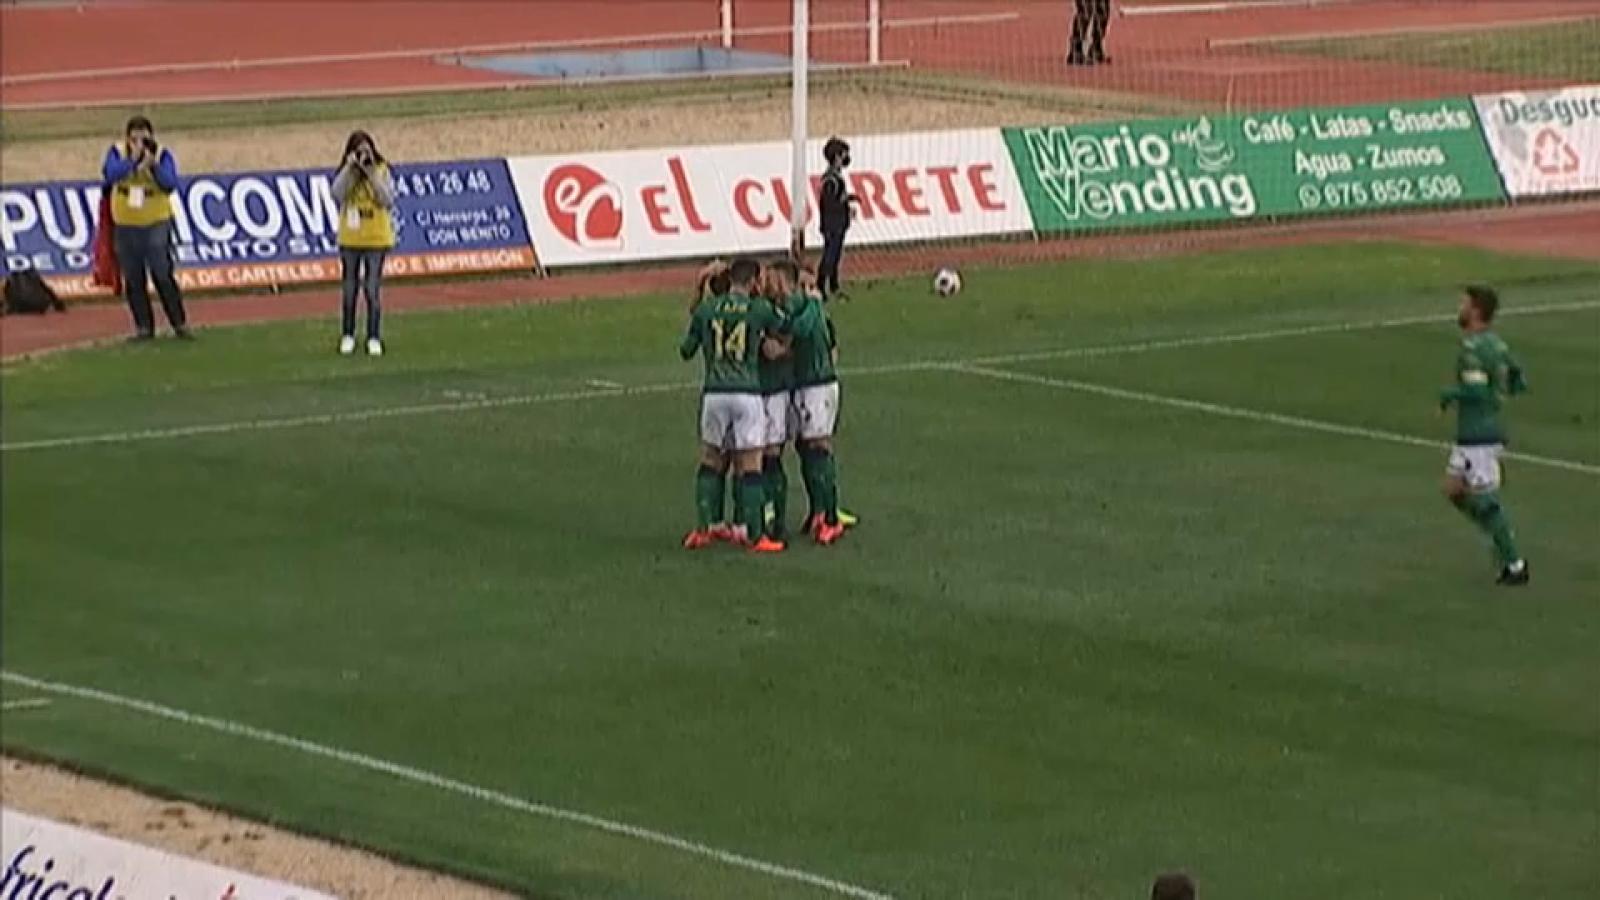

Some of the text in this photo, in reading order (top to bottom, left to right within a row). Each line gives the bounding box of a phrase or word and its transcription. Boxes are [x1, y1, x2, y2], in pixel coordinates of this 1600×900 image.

[1244, 104, 1472, 143] Café Latas Snacks
[1023, 125, 1171, 173] Mario
[1295, 144, 1446, 179] Agua Zumos
[0, 174, 339, 251] PUICOM
[1039, 168, 1257, 218] Vending
[7, 252, 55, 271] DE
[172, 238, 277, 262] ENITO
[427, 228, 459, 245] DON
[227, 261, 325, 285] CARTELES
[710, 317, 748, 362] 14
